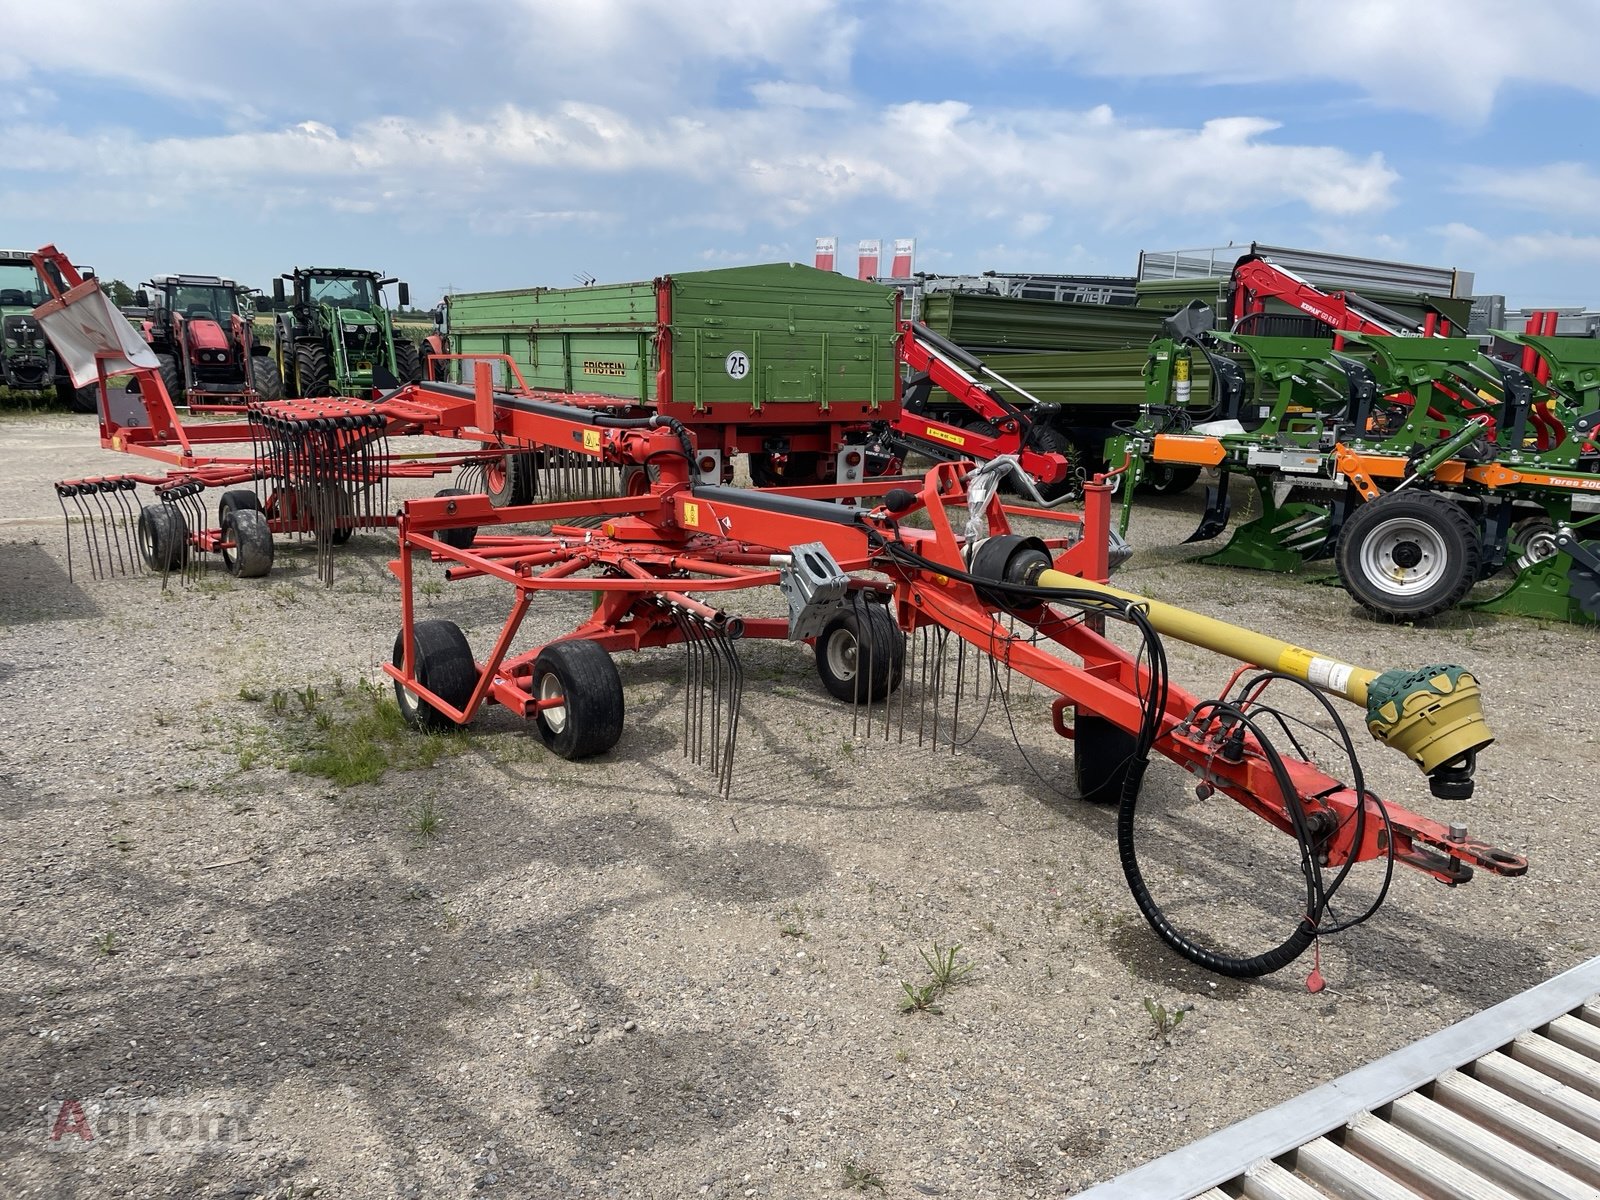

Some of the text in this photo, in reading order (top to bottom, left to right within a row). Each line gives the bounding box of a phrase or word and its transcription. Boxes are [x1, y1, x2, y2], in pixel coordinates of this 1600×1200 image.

[583, 361, 626, 375] FRISTEIN
[730, 356, 745, 375] 25
[1549, 477, 1580, 487] Teres
